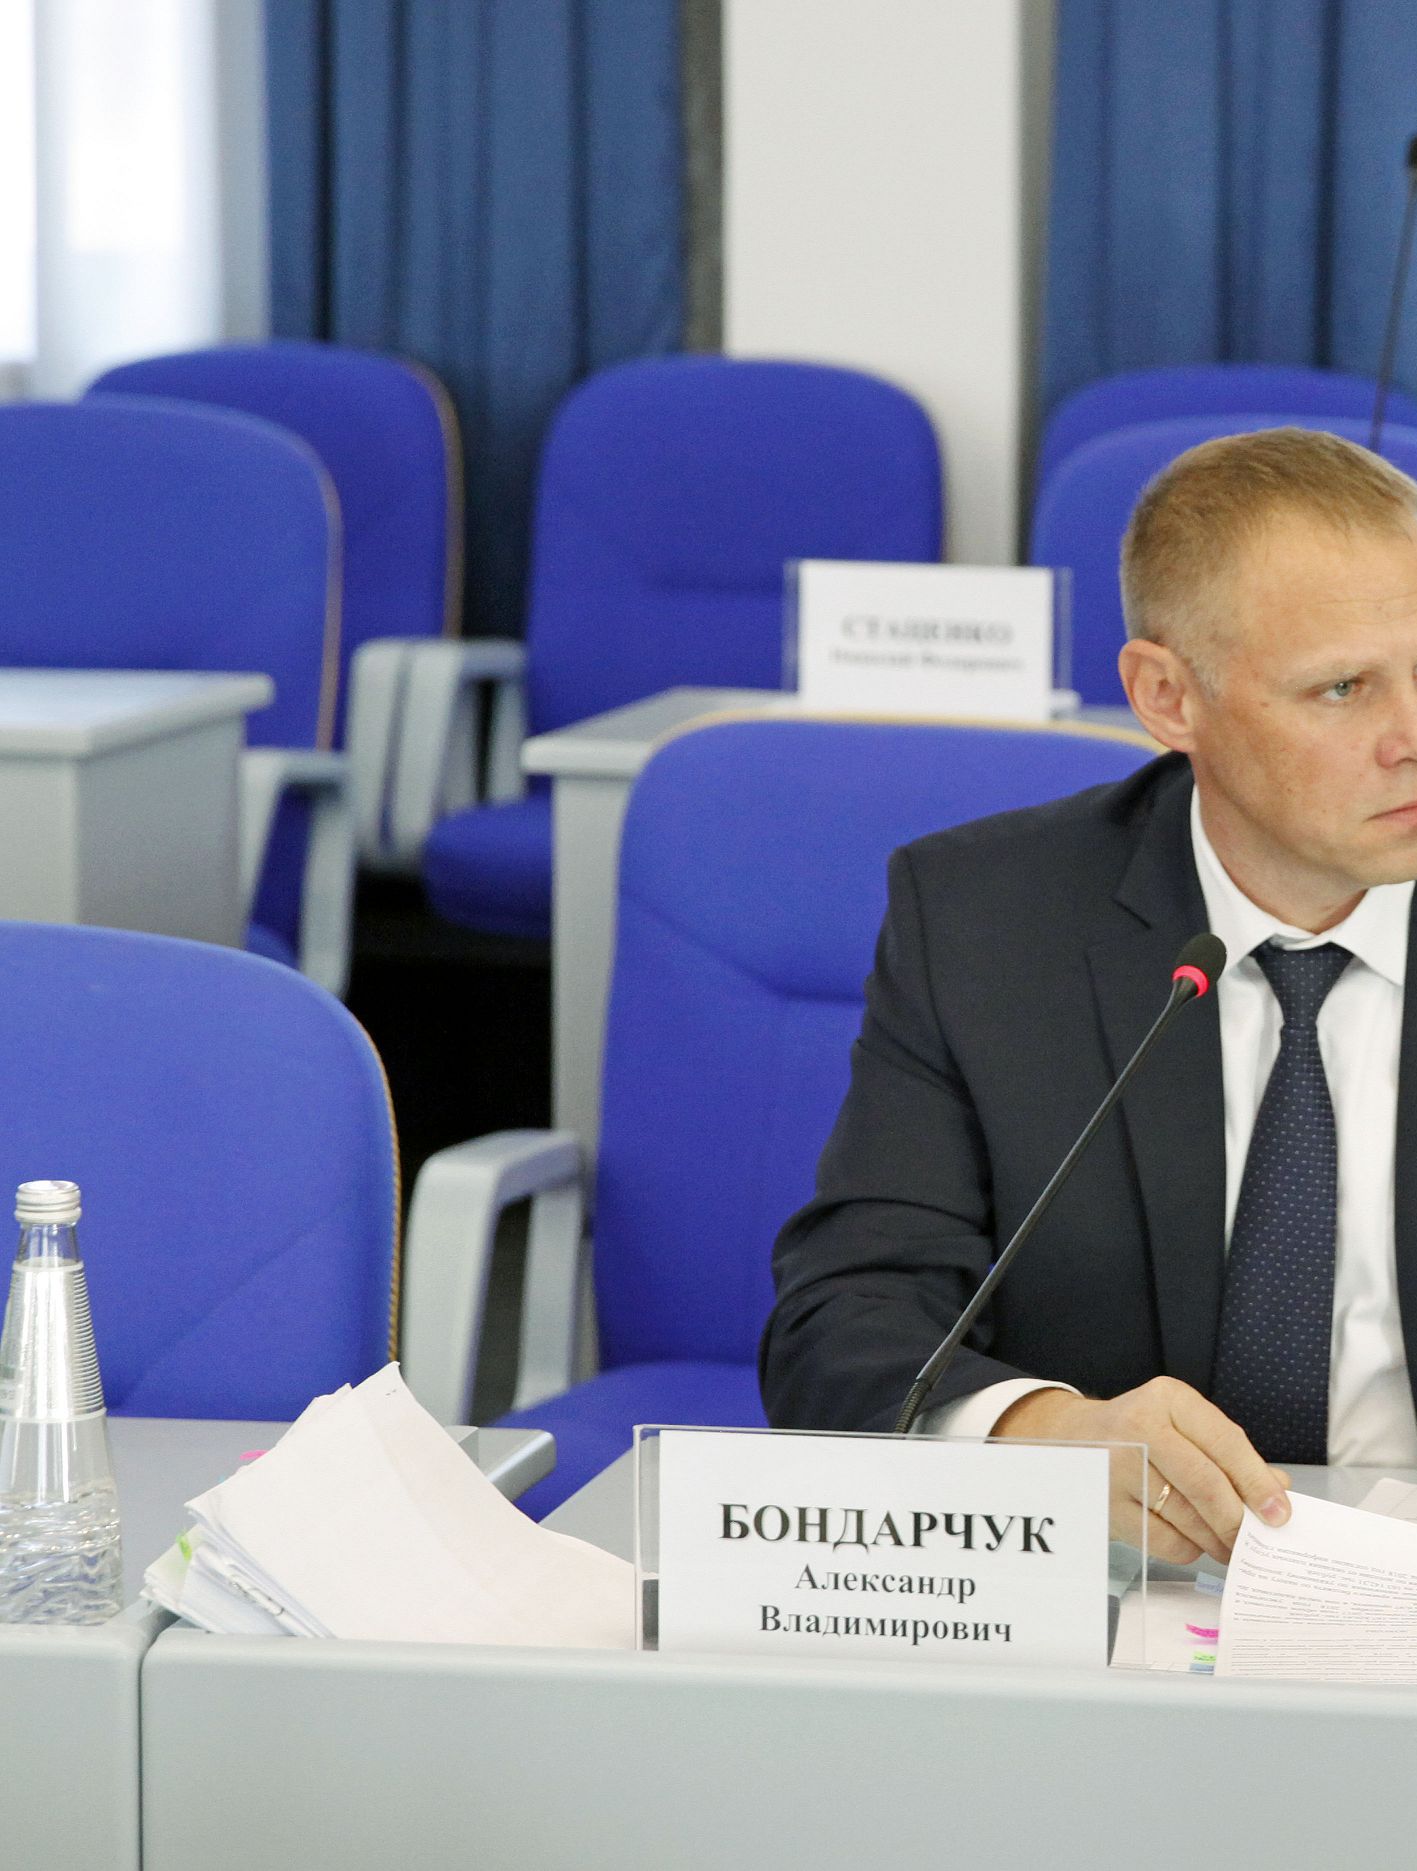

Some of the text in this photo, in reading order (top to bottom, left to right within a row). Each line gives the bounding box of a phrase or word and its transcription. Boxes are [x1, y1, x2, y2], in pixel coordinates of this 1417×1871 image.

[719, 1503, 1056, 1554] БОНДАРЧУК
[795, 1563, 977, 1604] Александр
[759, 1604, 1013, 1647] Владимирович
